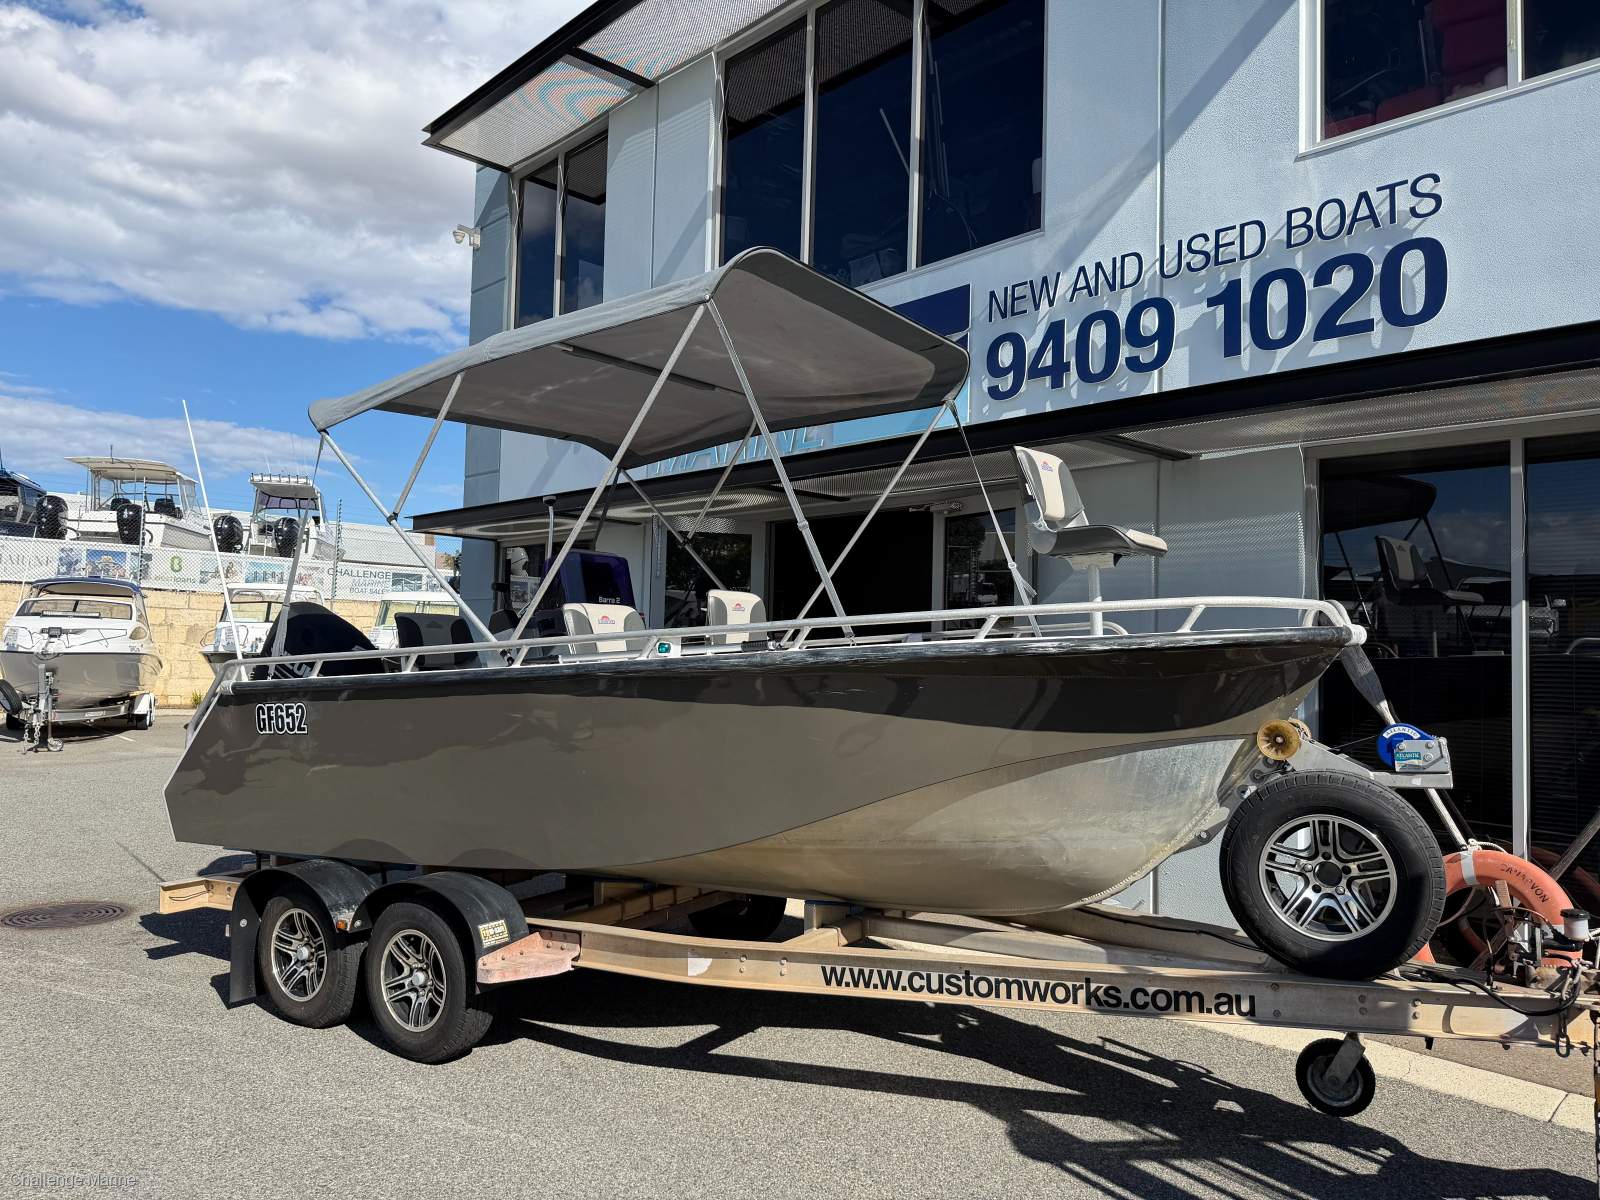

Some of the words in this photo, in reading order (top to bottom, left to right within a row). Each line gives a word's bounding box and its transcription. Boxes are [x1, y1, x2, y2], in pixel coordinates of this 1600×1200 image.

[988, 272, 1061, 322] NEW
[1069, 252, 1143, 303] AND
[1158, 220, 1266, 280] USED
[1286, 173, 1443, 249] BOATS
[986, 297, 1175, 400] 9409
[1207, 237, 1448, 358] 1020
[327, 567, 392, 580] CHALLENGE
[255, 702, 308, 735] GF652
